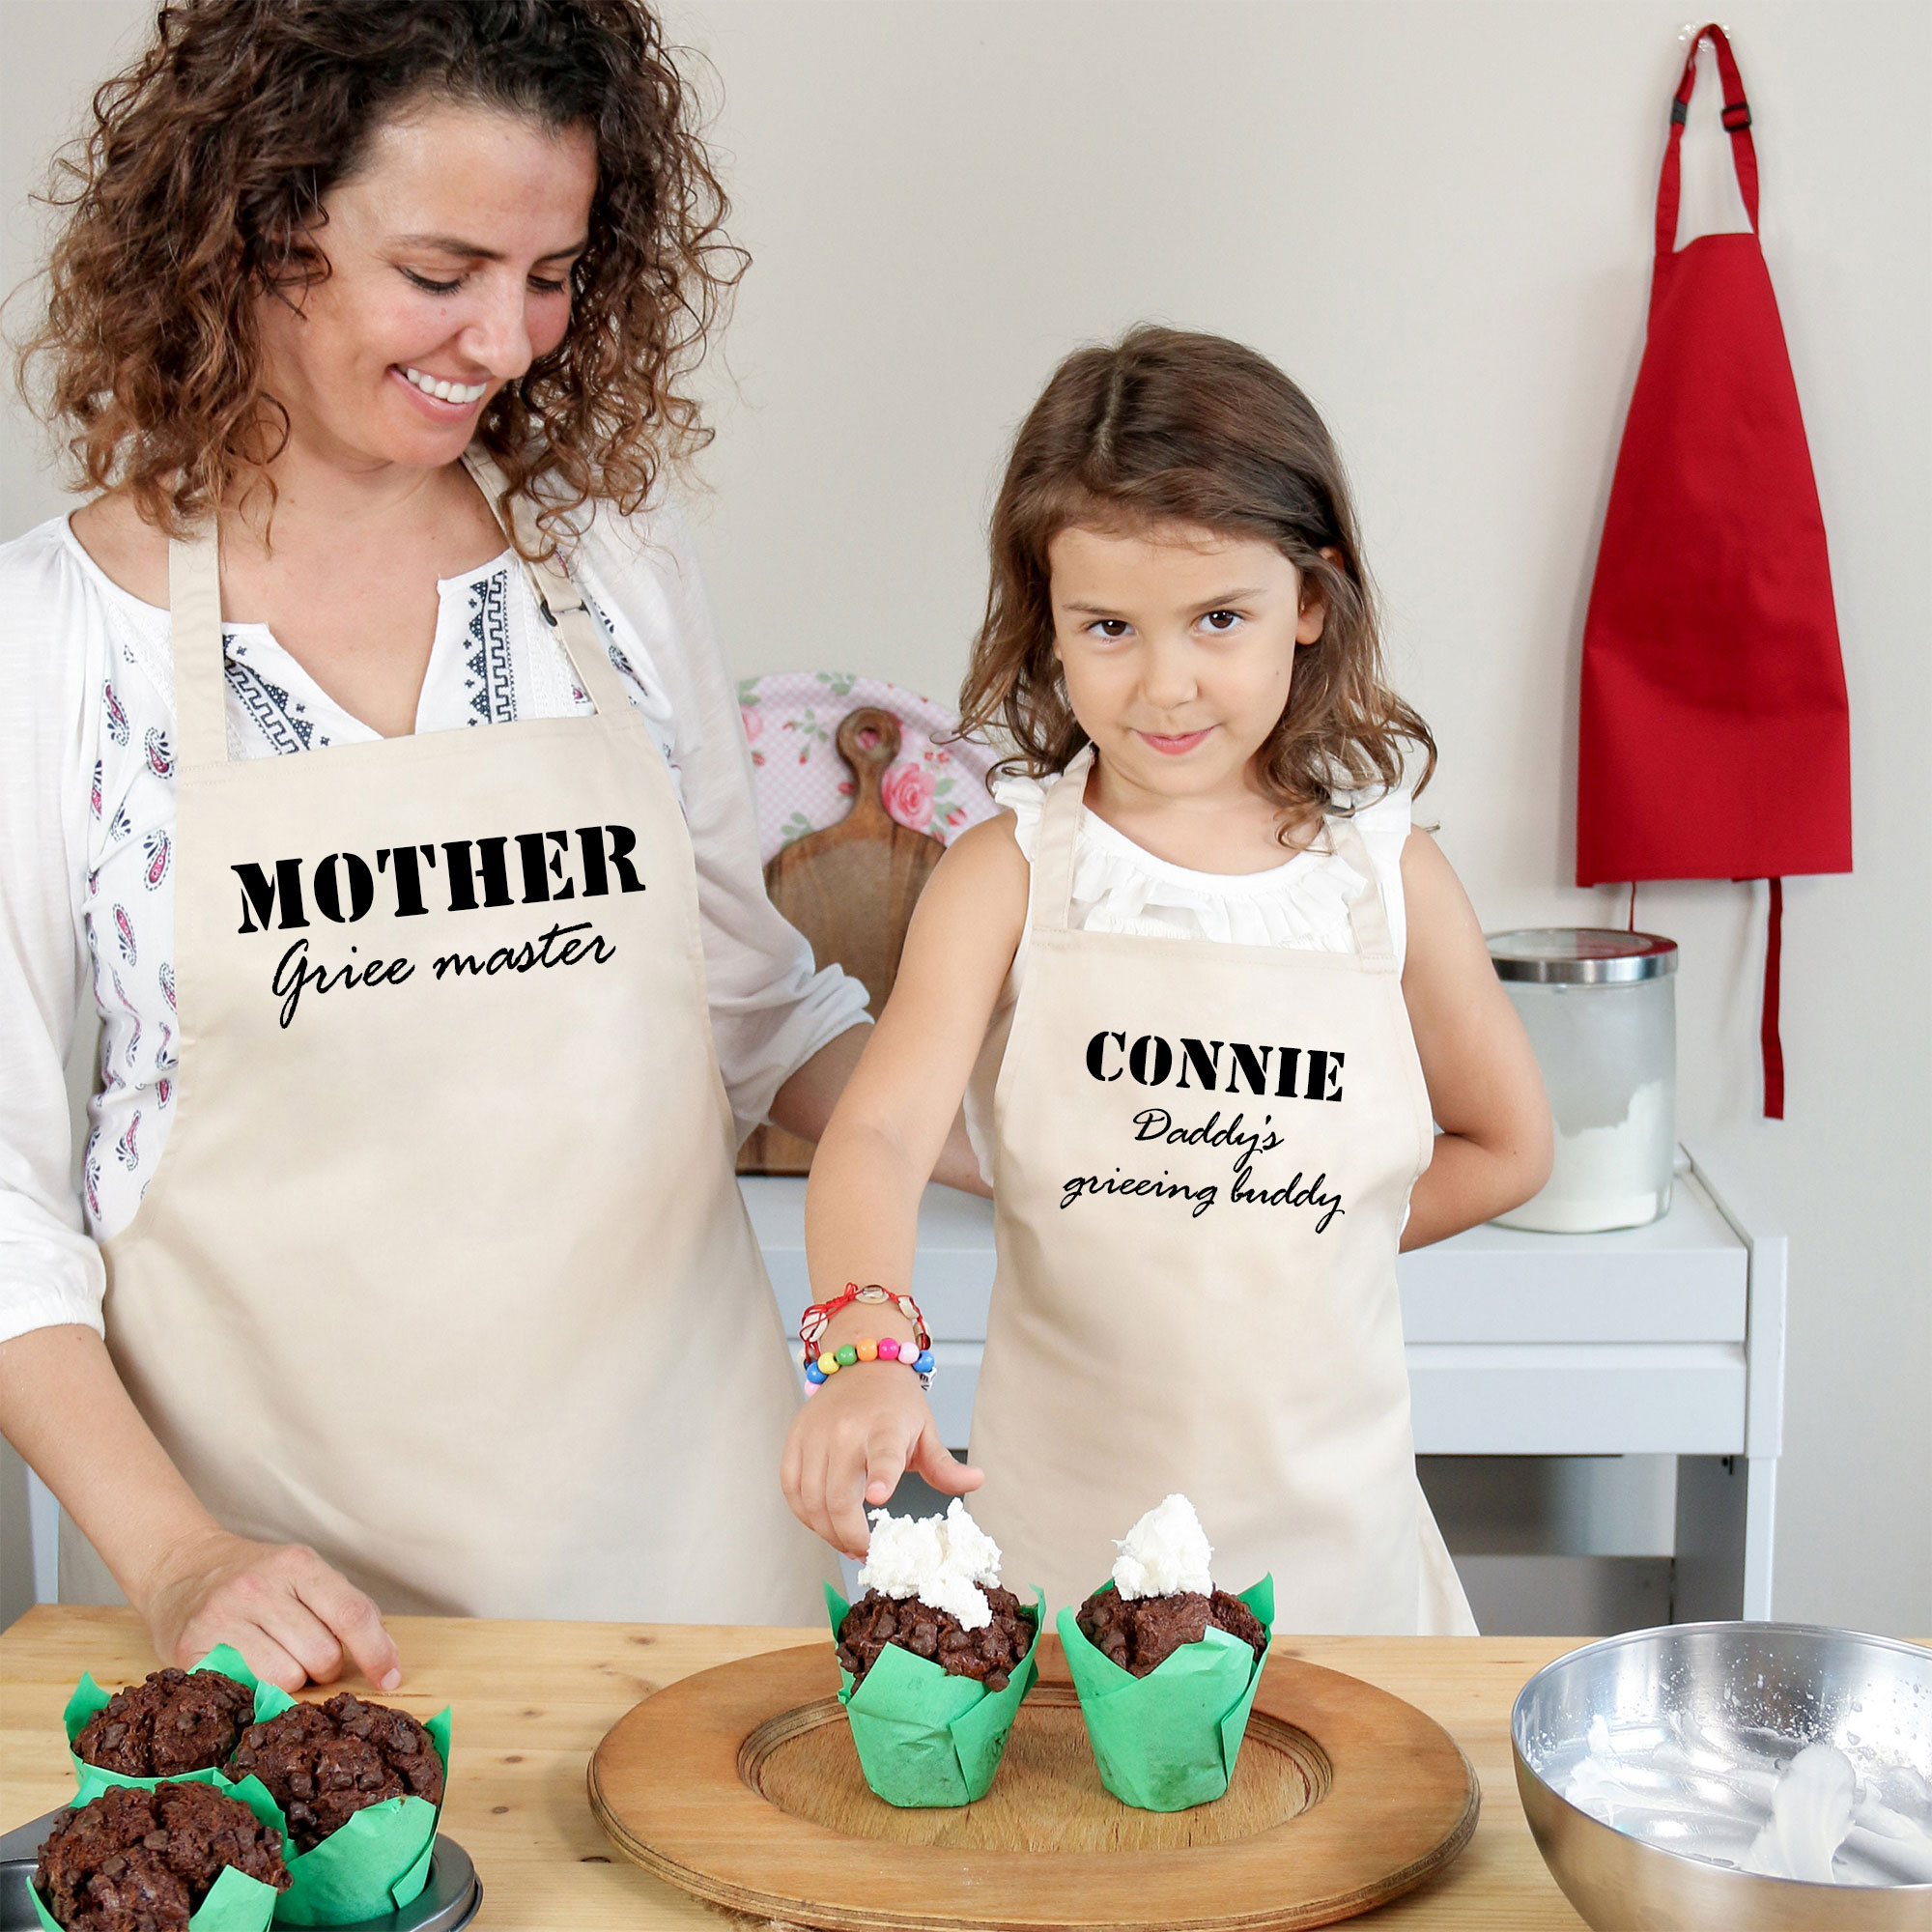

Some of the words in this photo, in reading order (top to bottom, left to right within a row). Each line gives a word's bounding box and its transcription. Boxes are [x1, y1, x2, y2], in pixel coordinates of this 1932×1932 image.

[230, 825, 646, 934] MOTHER
[432, 922, 617, 980] master
[1086, 1030, 1346, 1102] CONNIE
[1132, 1108, 1285, 1173] Daddy's
[1230, 1165, 1346, 1235] buddy
